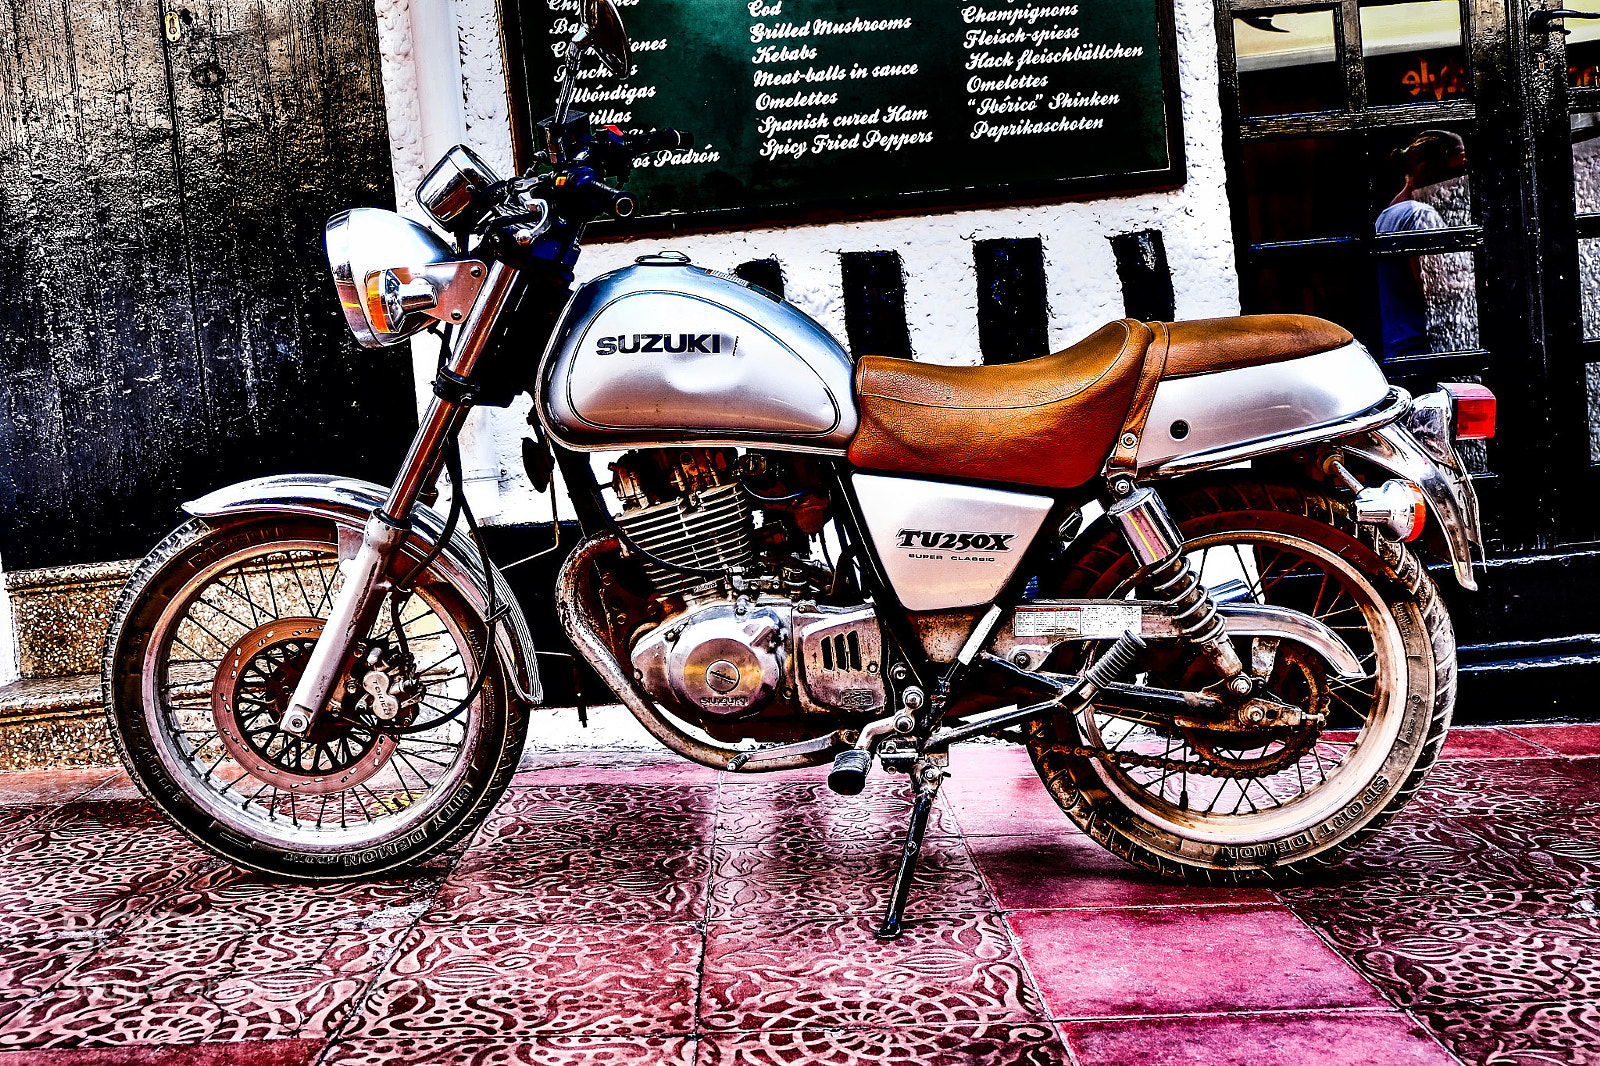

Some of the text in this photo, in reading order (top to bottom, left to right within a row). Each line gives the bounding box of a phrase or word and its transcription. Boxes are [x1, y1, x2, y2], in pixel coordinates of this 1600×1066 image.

[748, 0, 782, 17] Cod
[961, 3, 1079, 25] Champignons
[750, 17, 912, 43] Grilled Mushrooms
[963, 24, 1080, 49] Fleisch-spiess
[751, 44, 818, 64] Kebabs
[965, 42, 1143, 71] Hack fleischbällchen
[754, 63, 918, 87] Meat-balls in sauce
[966, 74, 1049, 93] Omelettes
[555, 83, 656, 105] lbóndigas
[756, 91, 838, 110] Omelettes
[1048, 91, 1120, 109] Shinken
[758, 105, 928, 140] Spanish cured Ham
[970, 116, 1104, 142] Paprikaschoten
[654, 144, 721, 168] Padrón
[760, 130, 933, 161] Spicy Fried Peppers
[596, 333, 720, 355] SUZUKI
[896, 529, 1018, 552] TU250X
[700, 696, 749, 706] SUZUKI
[432, 782, 473, 831] CITY
[1221, 775, 1391, 859] SPORT DEMON
[342, 826, 428, 867] DEMON
